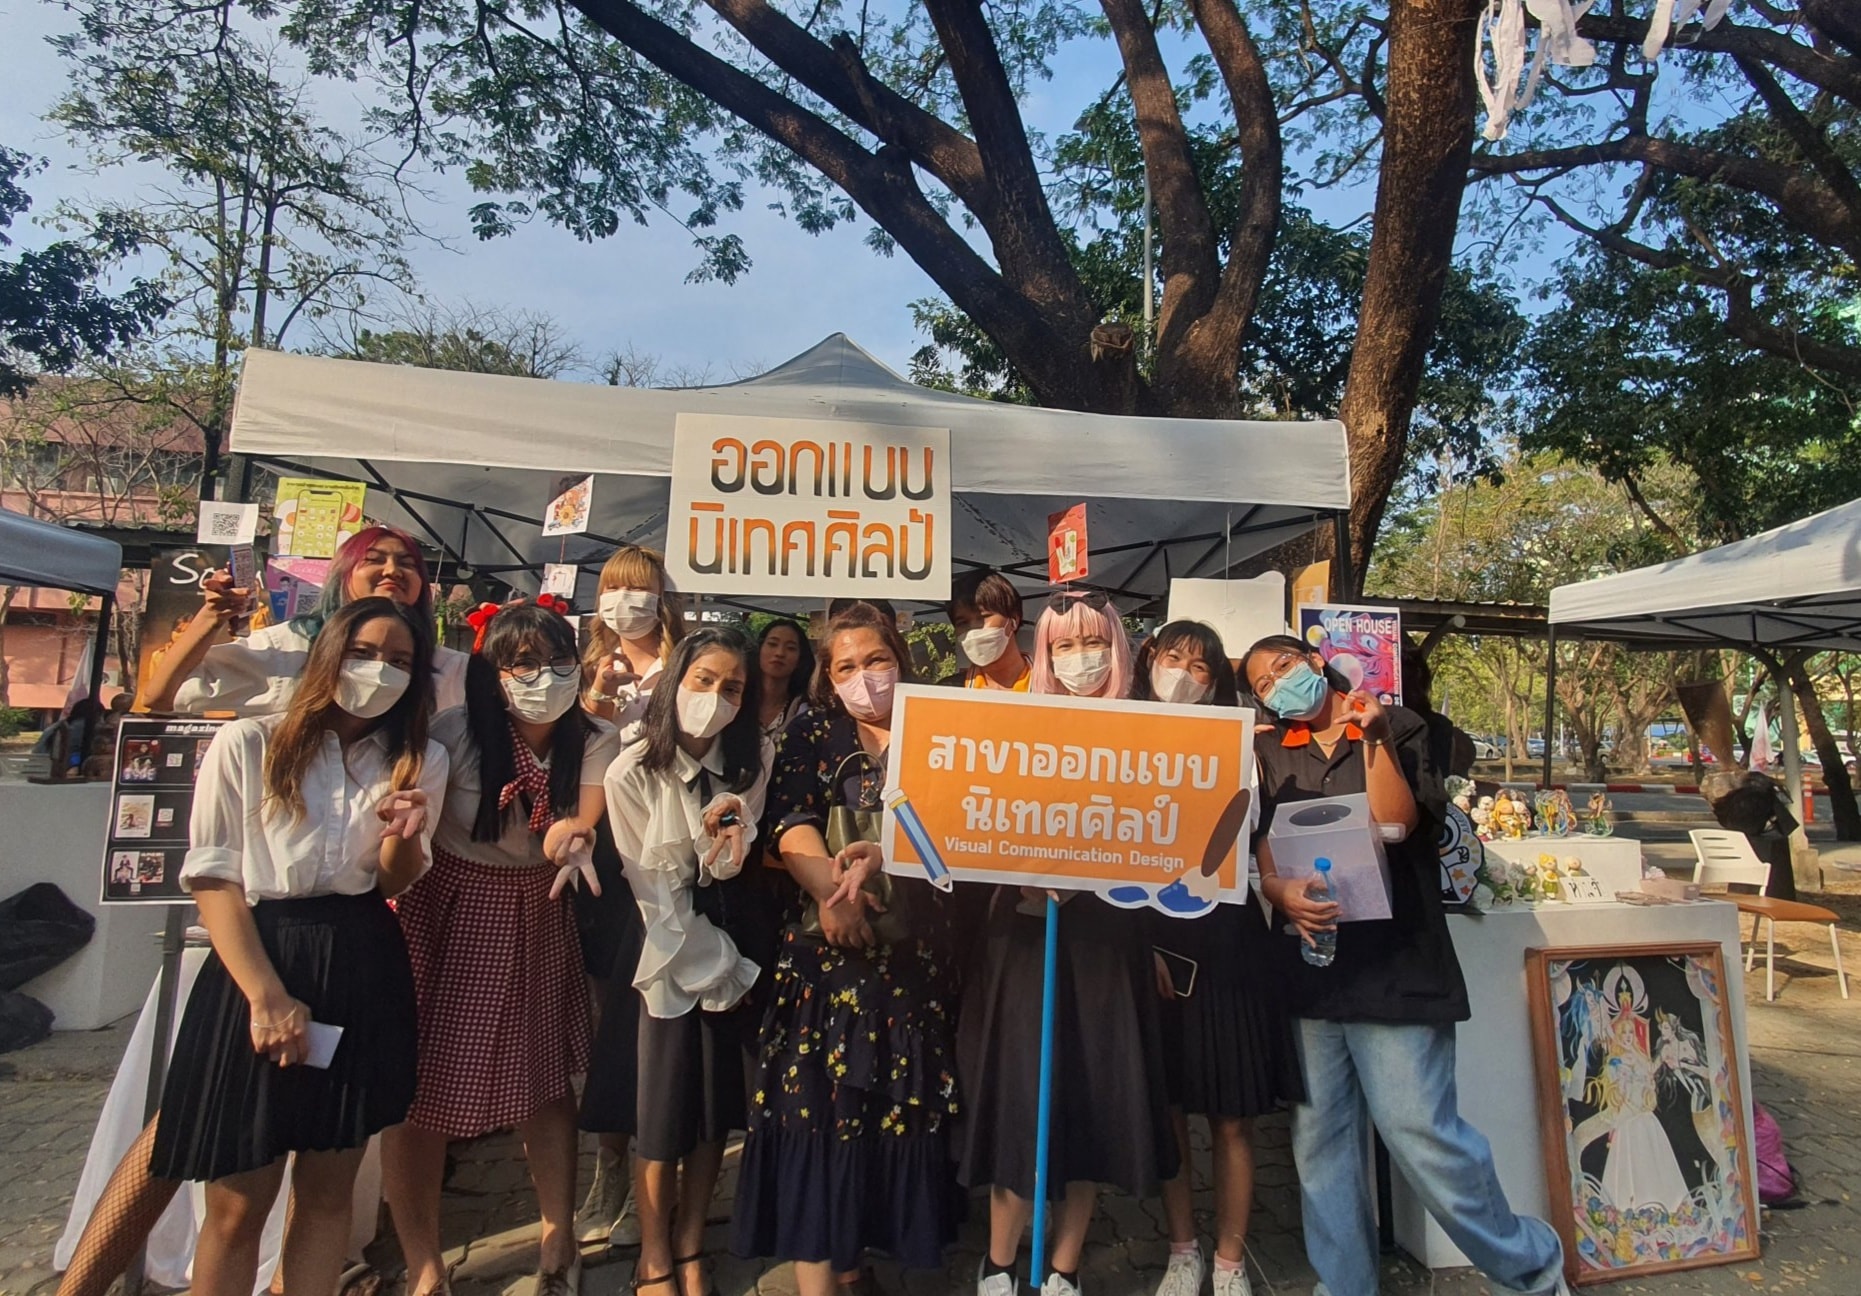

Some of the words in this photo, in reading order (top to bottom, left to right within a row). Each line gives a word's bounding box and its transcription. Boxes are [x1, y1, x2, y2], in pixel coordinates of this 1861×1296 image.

[711, 437, 934, 500] ออกแบบ
[1324, 617, 1353, 632] OPEN
[1356, 619, 1392, 635] HOUSE
[928, 735, 1219, 790] สาขาออกแบบ
[961, 785, 1180, 845] นิเทศศิลป์
[945, 836, 992, 854] Visual
[998, 840, 1123, 865] Communication
[1129, 851, 1185, 873] Design
